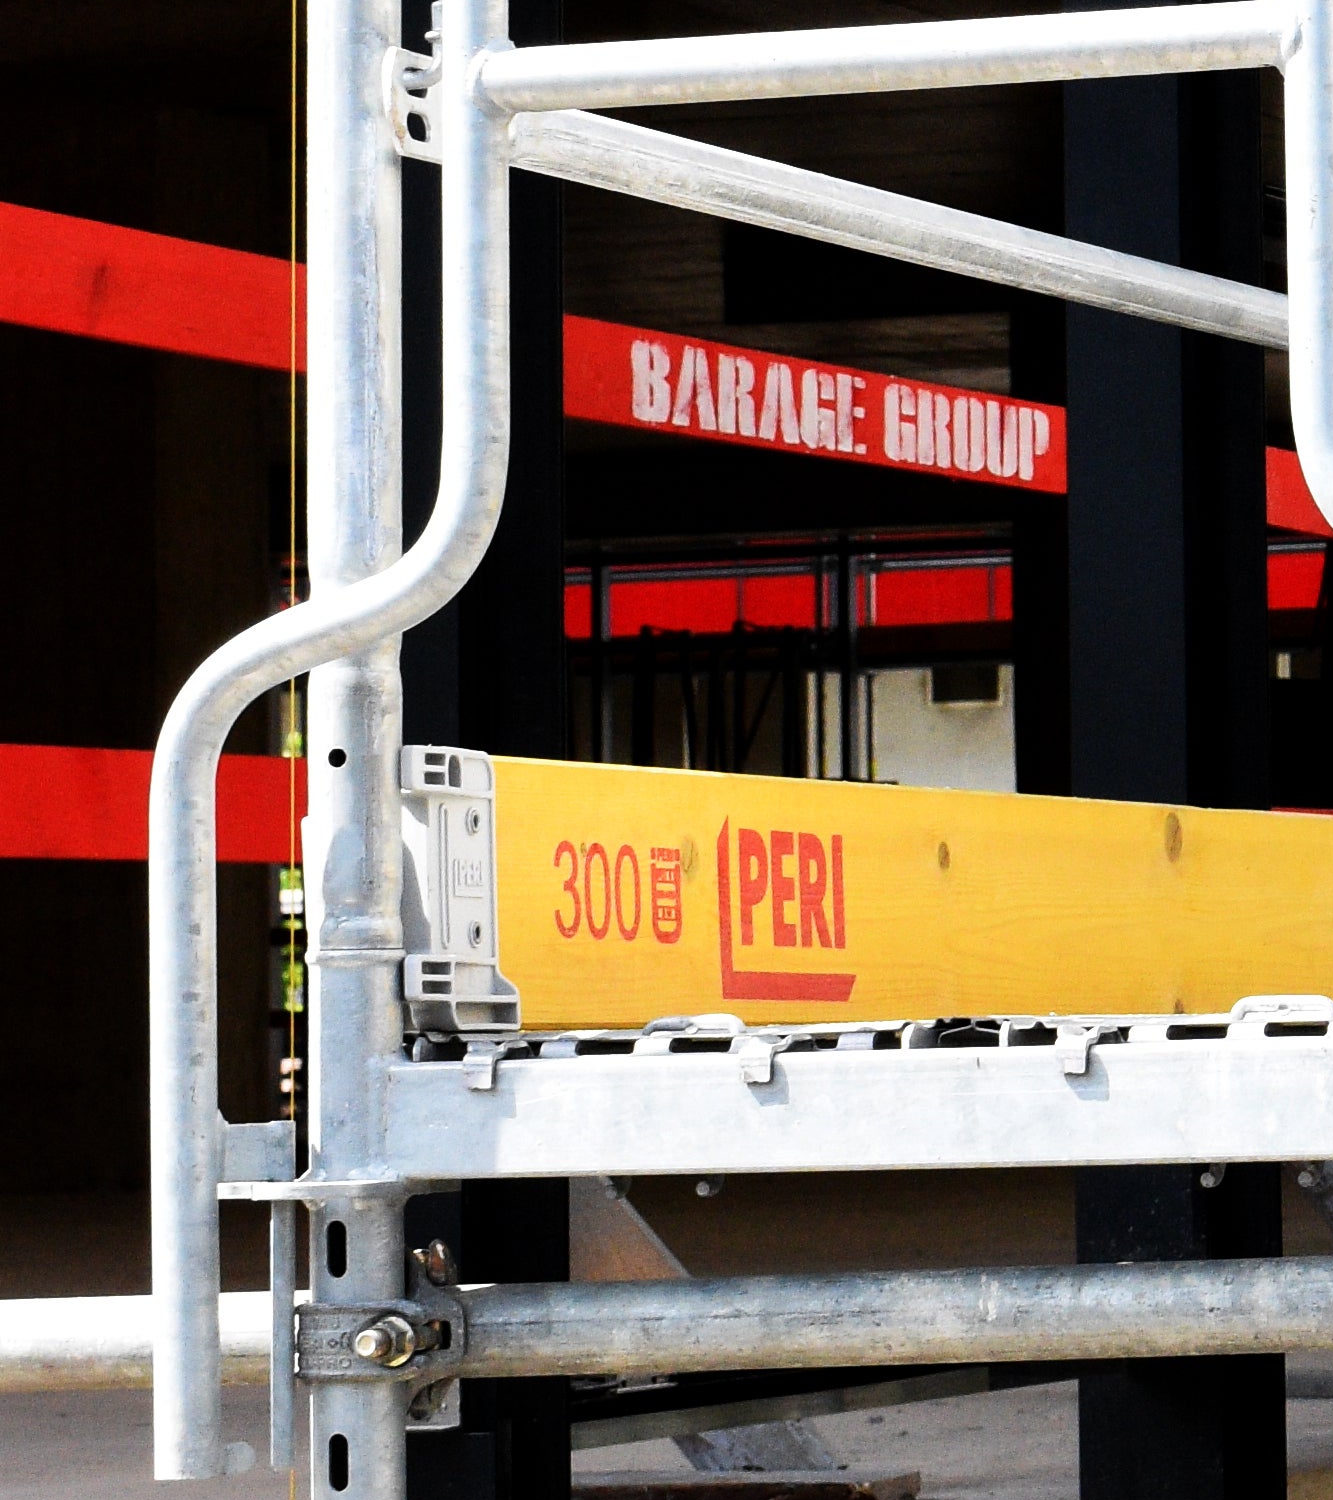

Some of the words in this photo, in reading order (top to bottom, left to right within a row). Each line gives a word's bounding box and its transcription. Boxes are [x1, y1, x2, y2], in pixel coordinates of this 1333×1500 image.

[630, 339, 868, 456] BARAGE
[884, 382, 1051, 482] GROUP
[554, 839, 641, 942] 300
[738, 827, 847, 950] PERI
